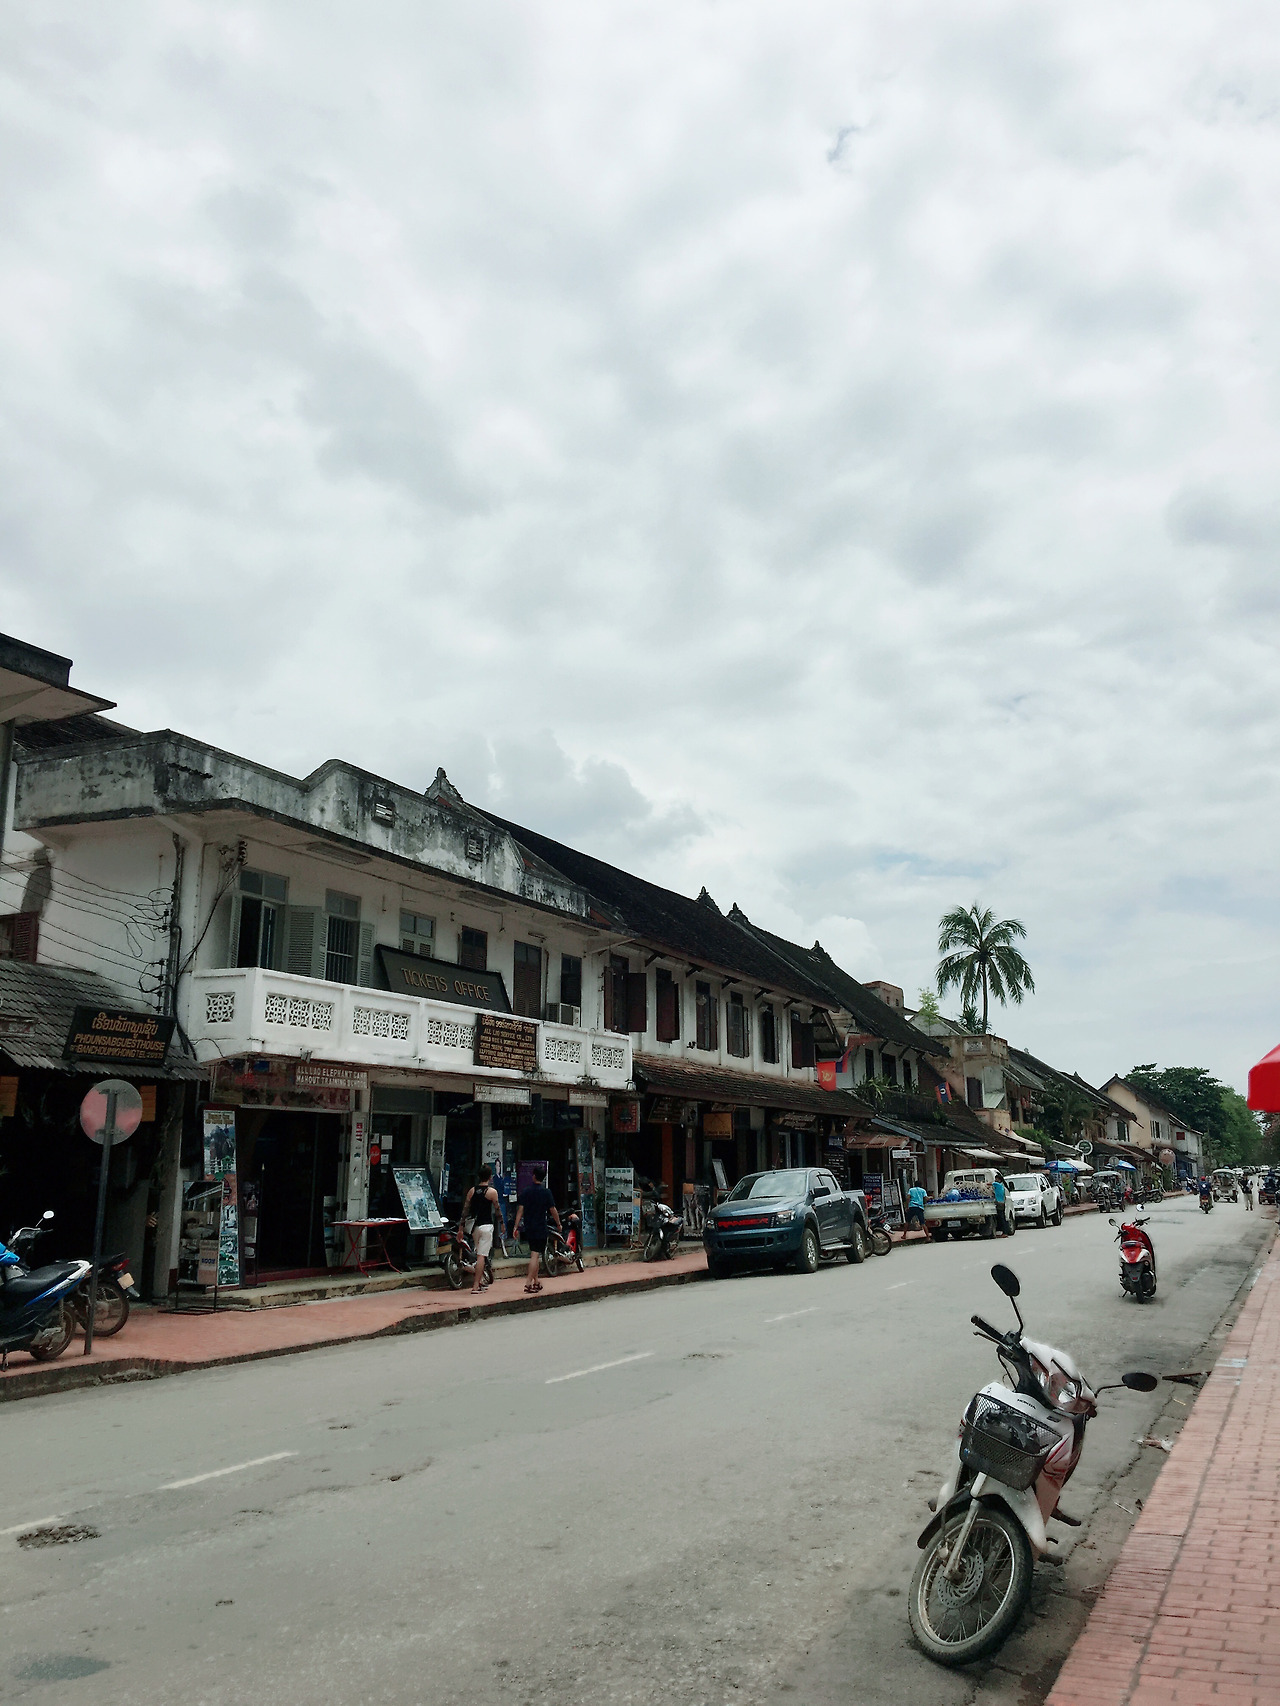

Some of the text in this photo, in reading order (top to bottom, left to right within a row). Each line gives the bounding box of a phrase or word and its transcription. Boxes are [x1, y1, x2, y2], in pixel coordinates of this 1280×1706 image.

[401, 968, 491, 1001] TICKETS OFFICE
[296, 1065, 308, 1075] ALL
[310, 1067, 321, 1076] LAO
[322, 1068, 353, 1078] ELEPHANT
[296, 1075, 320, 1084] MAHOUT
[321, 1077, 346, 1086] TRAINING
[497, 1114, 536, 1126] AGENCY
[1017, 1398, 1037, 1409] HONDA
